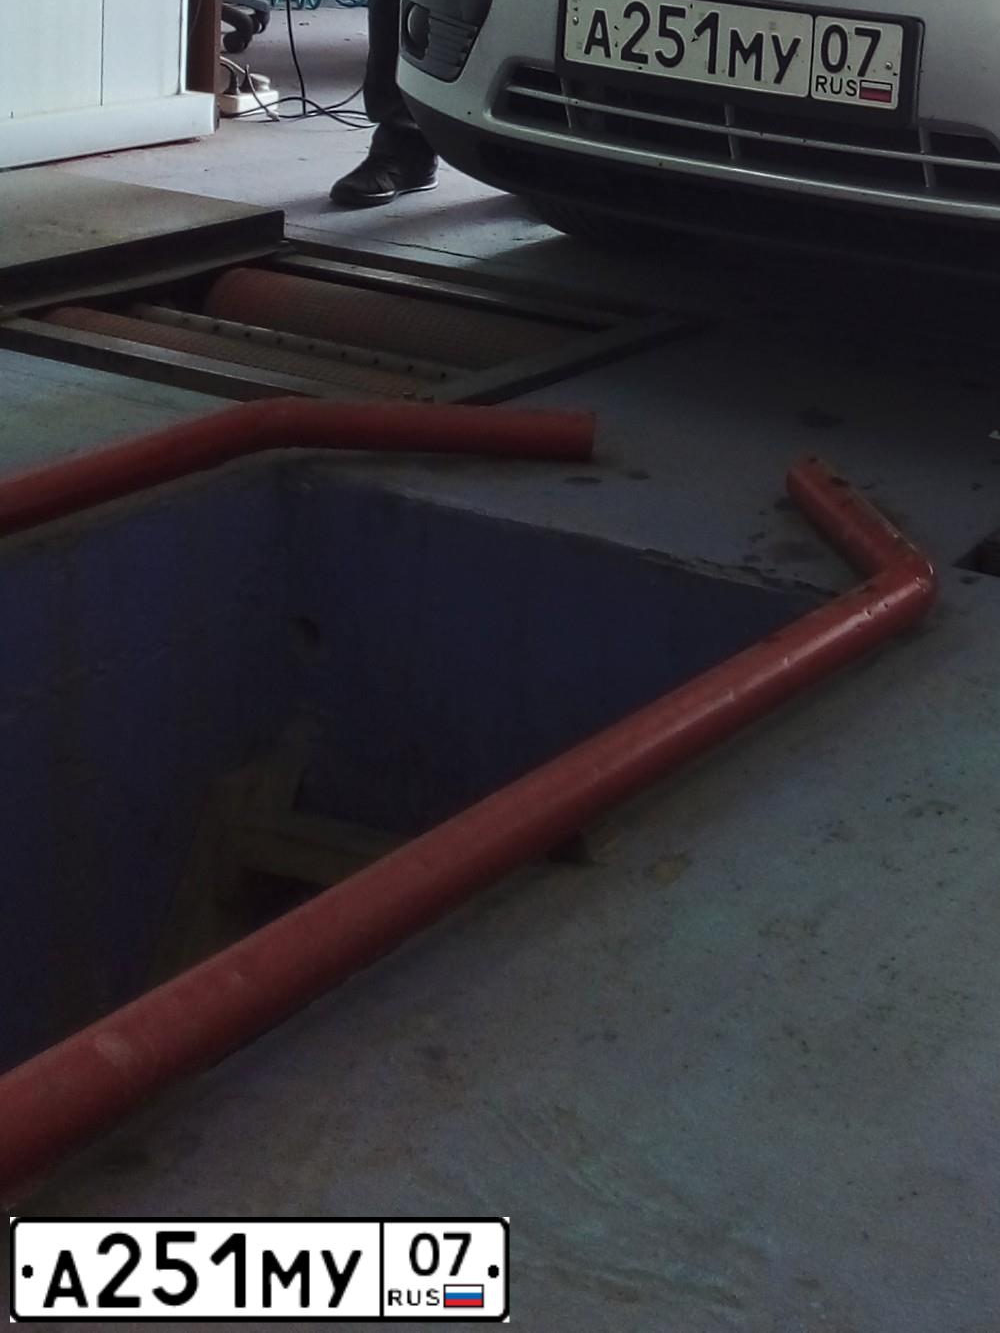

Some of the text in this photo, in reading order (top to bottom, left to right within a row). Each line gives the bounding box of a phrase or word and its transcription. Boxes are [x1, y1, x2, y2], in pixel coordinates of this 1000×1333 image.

[583, 0, 882, 85] А251МУ 07
[815, 75, 858, 97] RUS
